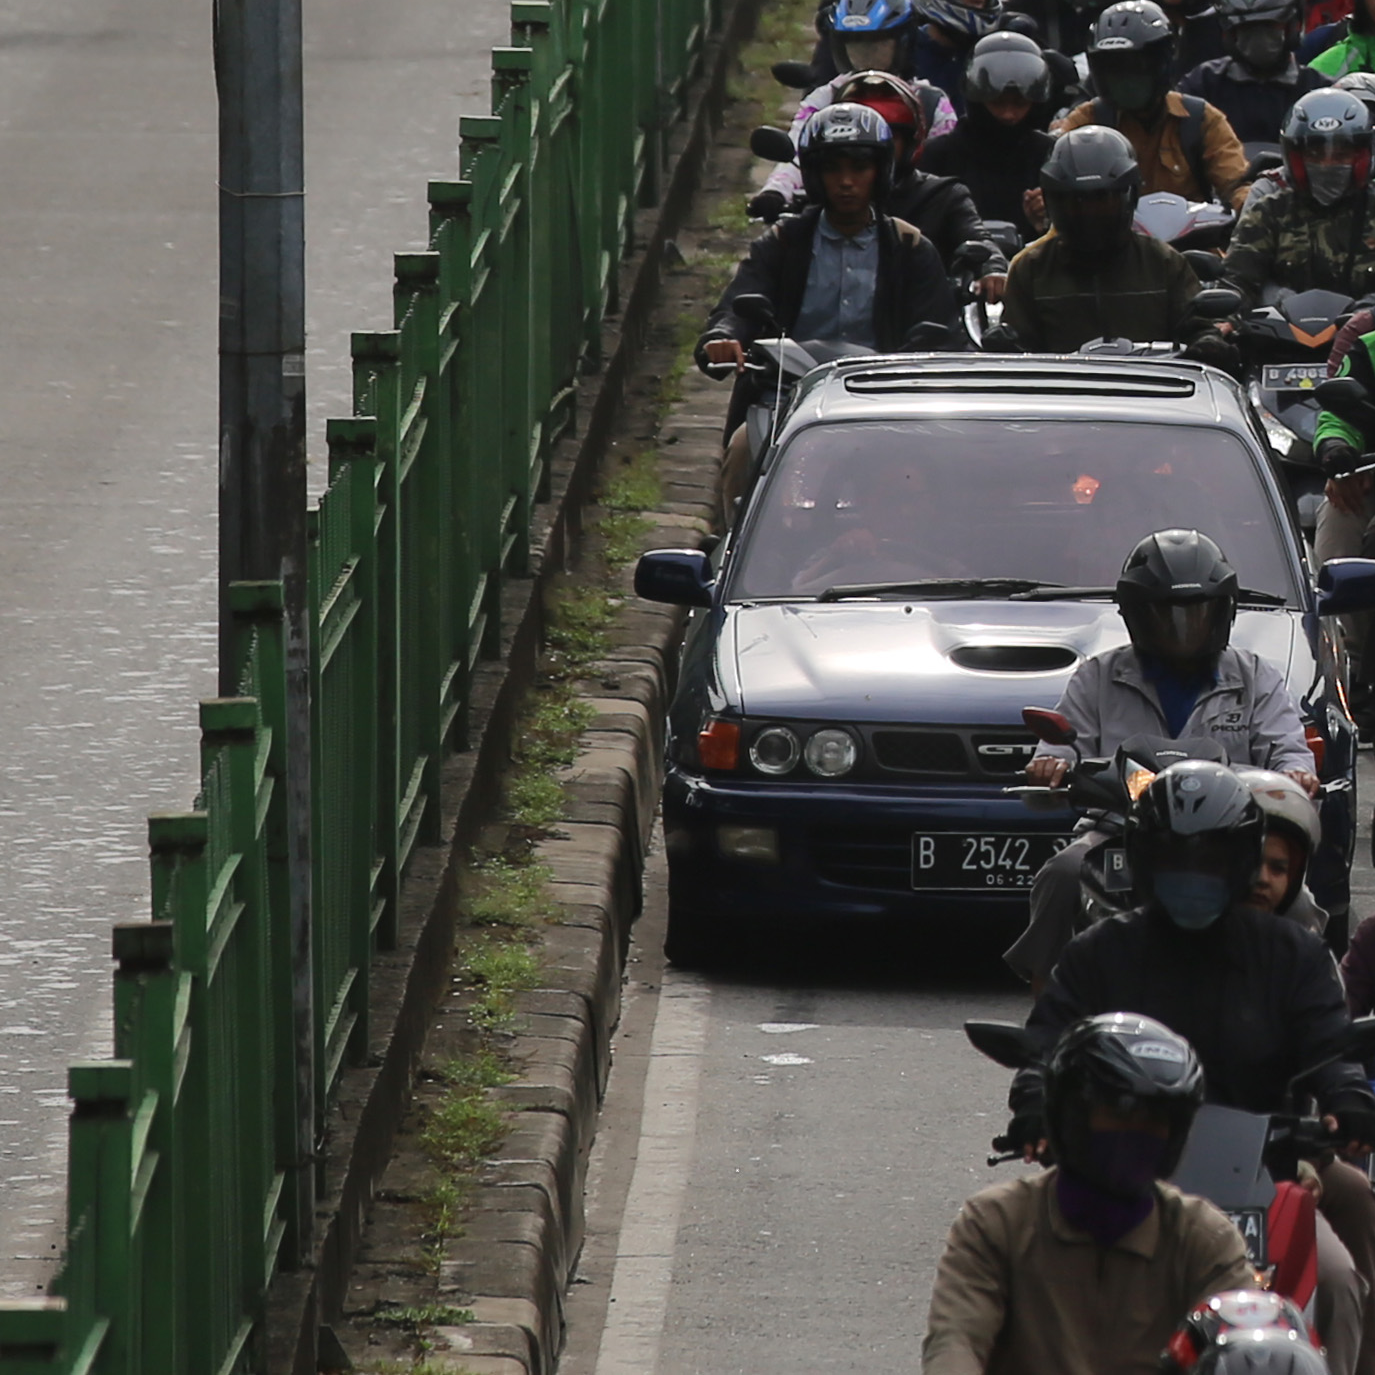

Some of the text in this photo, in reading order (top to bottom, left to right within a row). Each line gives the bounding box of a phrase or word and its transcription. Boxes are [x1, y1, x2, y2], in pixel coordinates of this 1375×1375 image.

[978, 744, 1038, 755] GT
[919, 836, 935, 869] B
[962, 837, 1030, 870] 2542
[1112, 853, 1123, 871] B
